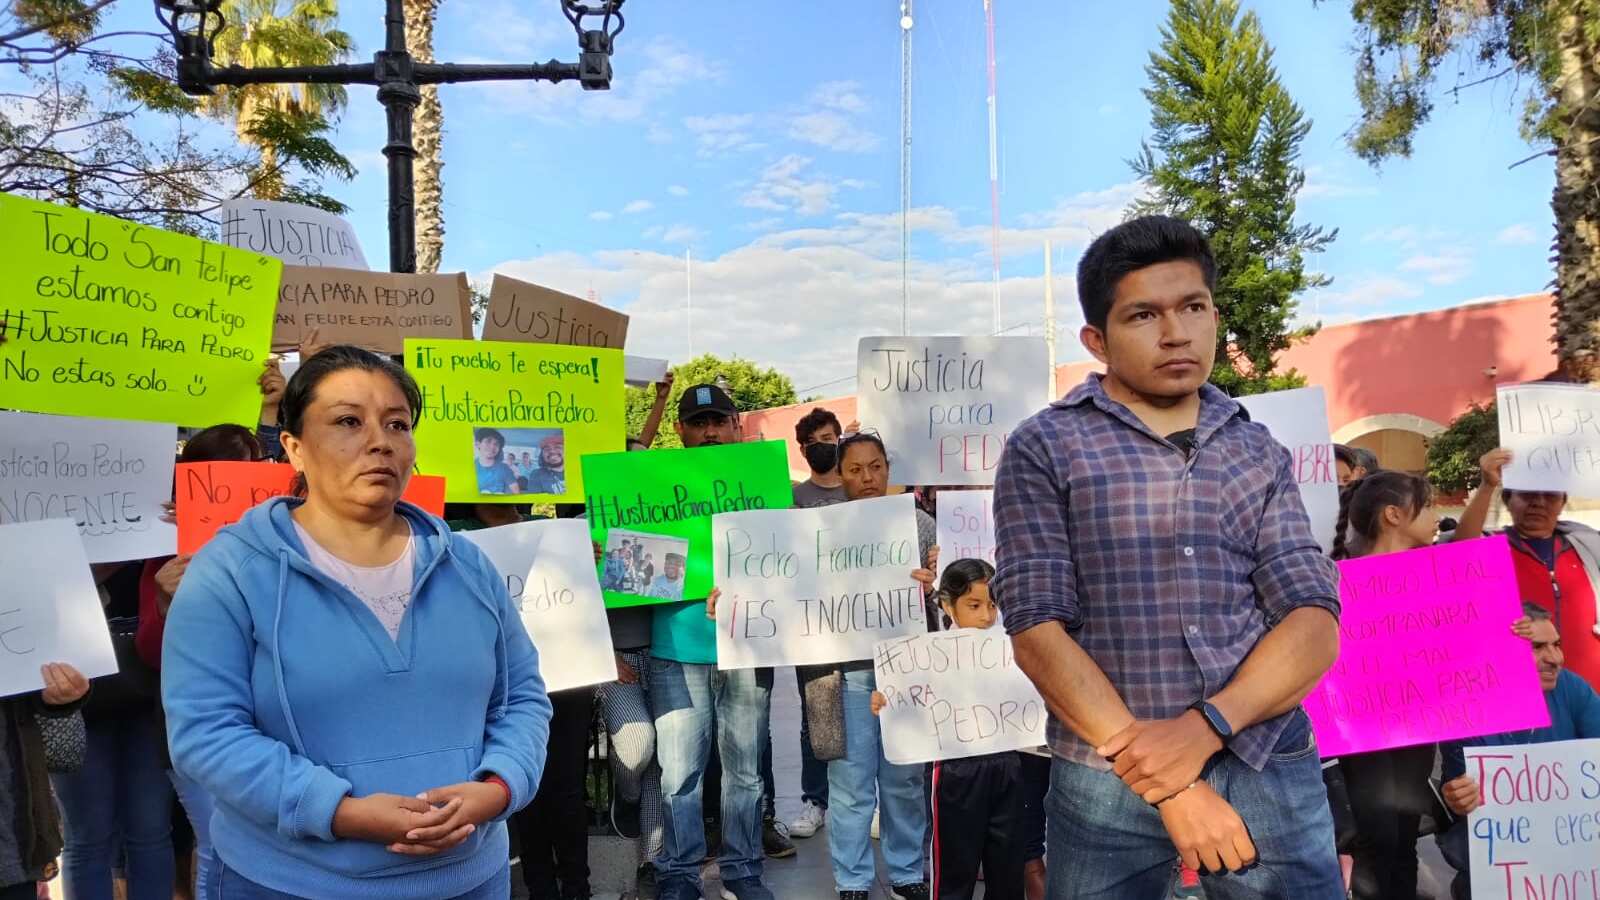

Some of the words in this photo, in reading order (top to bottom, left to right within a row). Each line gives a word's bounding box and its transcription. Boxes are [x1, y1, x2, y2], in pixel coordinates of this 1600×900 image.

[32, 210, 109, 262] Todo
[222, 208, 354, 258] #JUSTICIA
[36, 265, 157, 312] estamos
[172, 298, 245, 337] contigo
[321, 282, 369, 305] PARA
[374, 286, 435, 308] PEDRO
[492, 294, 609, 347] Justicia
[4, 350, 40, 383] No
[52, 357, 115, 388] estas
[416, 346, 442, 369] ¡Tu
[451, 351, 501, 373] pueblo
[507, 351, 526, 374] te
[538, 357, 600, 384] espera!
[871, 346, 984, 393] Justicia
[928, 402, 993, 440] para
[939, 432, 1008, 473] PED
[187, 464, 231, 505] No
[250, 484, 290, 507] pe
[726, 527, 800, 579] Pedro
[814, 526, 912, 576] Francisco
[506, 574, 575, 613] Pedro
[799, 579, 925, 637] INOCENTE!
[877, 634, 1013, 677] #JUSTICI
[884, 684, 936, 712] PARA
[1438, 661, 1502, 697] PARA
[930, 699, 1040, 751] PEDRO
[1466, 753, 1570, 806] Todos
[1473, 815, 1531, 866] que
